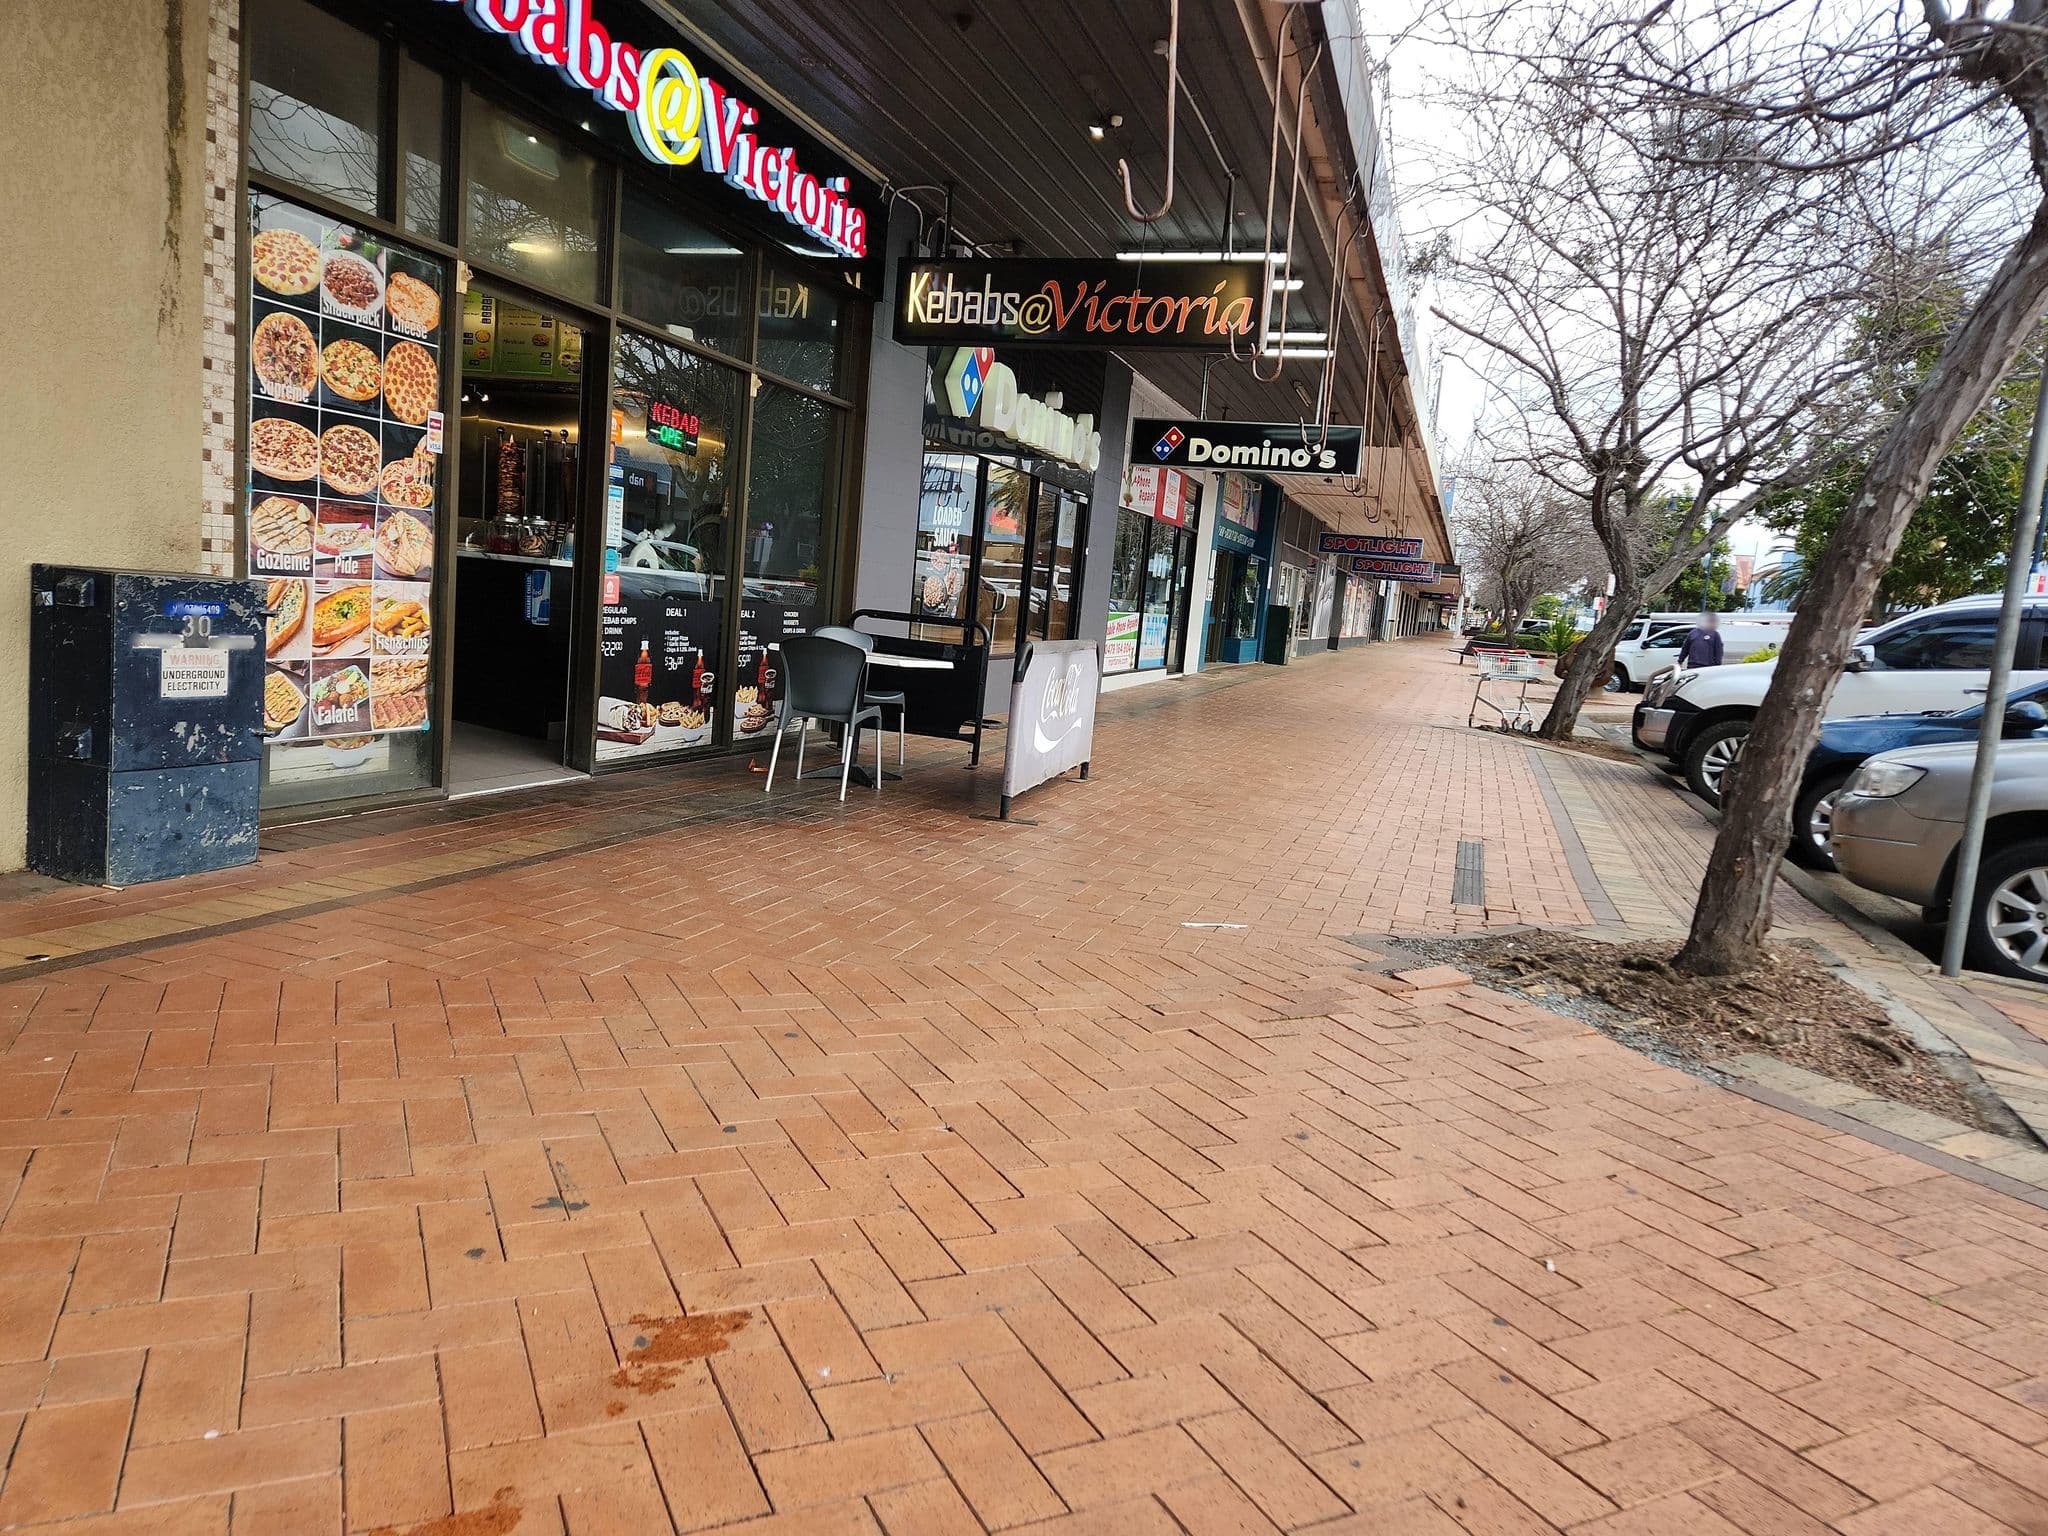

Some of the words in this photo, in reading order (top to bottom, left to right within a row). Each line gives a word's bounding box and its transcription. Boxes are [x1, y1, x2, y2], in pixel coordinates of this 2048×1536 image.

[651, 401, 700, 436] KEBAB
[1188, 437, 1337, 469] Domino's
[1323, 537, 1418, 555] SPOTLIGHT
[256, 549, 311, 571] Gozleme
[334, 554, 359, 574] Pide
[1355, 558, 1431, 575] SPOTLIGHT
[665, 608, 683, 617] DEAL
[684, 608, 687, 617] 1
[751, 610, 756, 618] 2
[182, 615, 211, 638] 30
[620, 617, 638, 625] CHIPS
[604, 627, 623, 635] DRINK
[170, 655, 220, 666] WARNING
[162, 670, 226, 680] UNDERGROUND
[167, 681, 220, 691] ELECTRICITY
